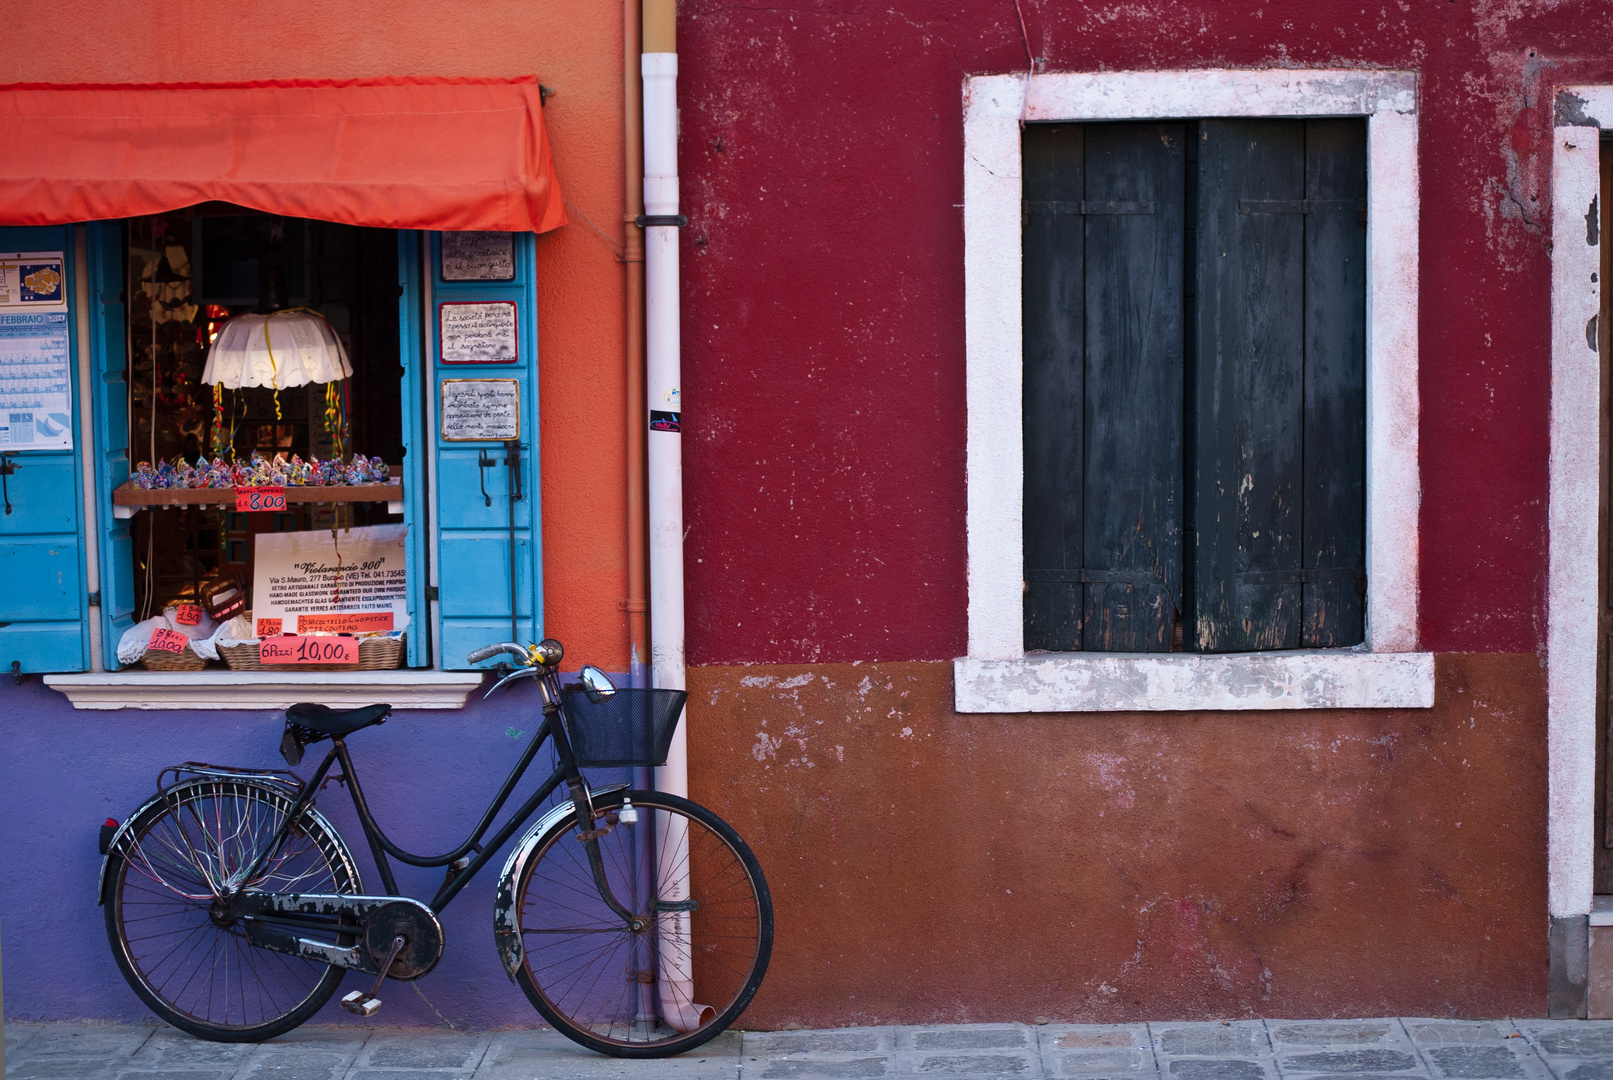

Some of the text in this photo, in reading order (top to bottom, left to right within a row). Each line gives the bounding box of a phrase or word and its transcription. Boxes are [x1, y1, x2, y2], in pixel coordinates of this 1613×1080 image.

[488, 258, 511, 272] gusto
[1, 315, 44, 324] FEBBRAIO
[346, 572, 360, 581] (VE)
[373, 570, 406, 578] 041.73545
